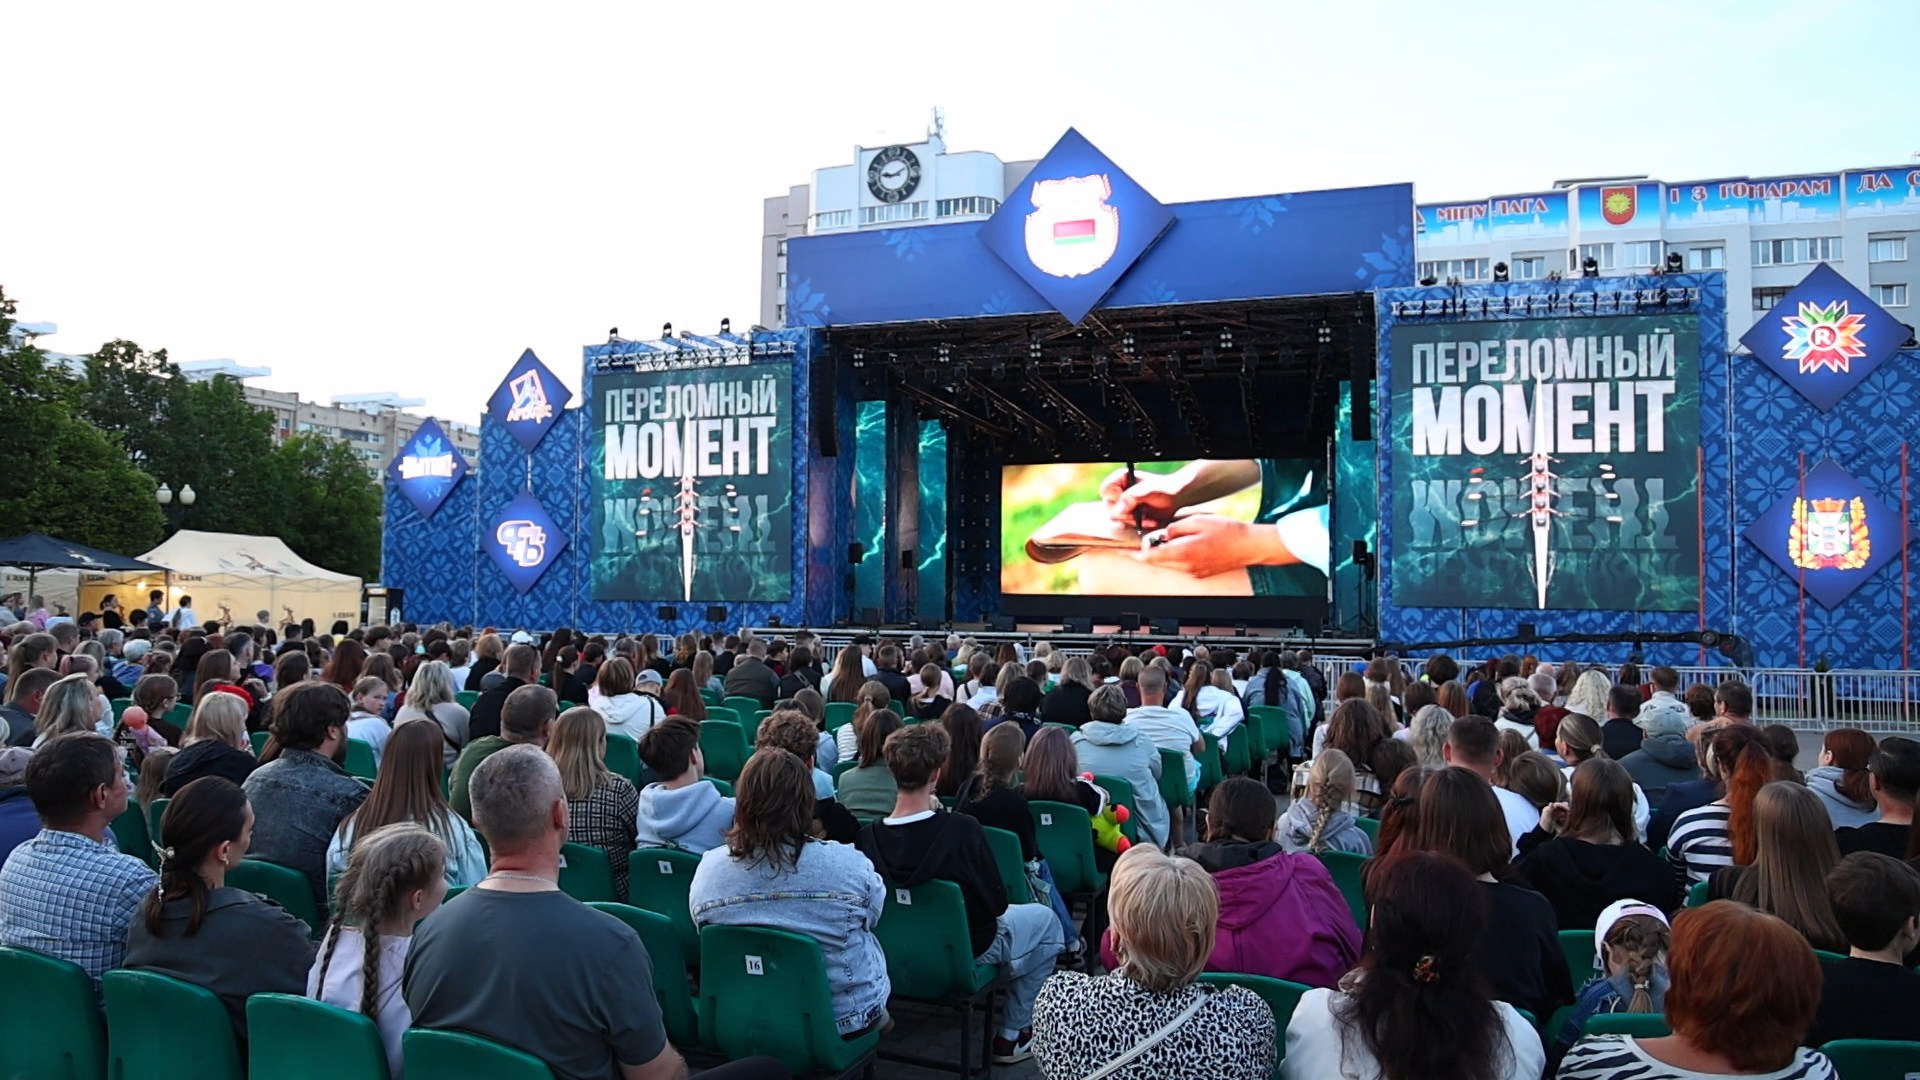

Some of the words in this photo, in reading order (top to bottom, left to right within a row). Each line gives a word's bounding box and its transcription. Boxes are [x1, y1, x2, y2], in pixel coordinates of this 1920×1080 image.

[1719, 179, 1831, 201] ГОНАРАМ
[1857, 173, 1895, 193] ДА
[1412, 328, 1676, 384] ПЕРЕЛОМНЫЙ
[604, 374, 777, 423] ПЕРЕЛОМНЫЙ
[1411, 379, 1676, 456] МОМЕНТ
[604, 416, 777, 481] МОМЕНТ
[748, 960, 761, 971] 16
